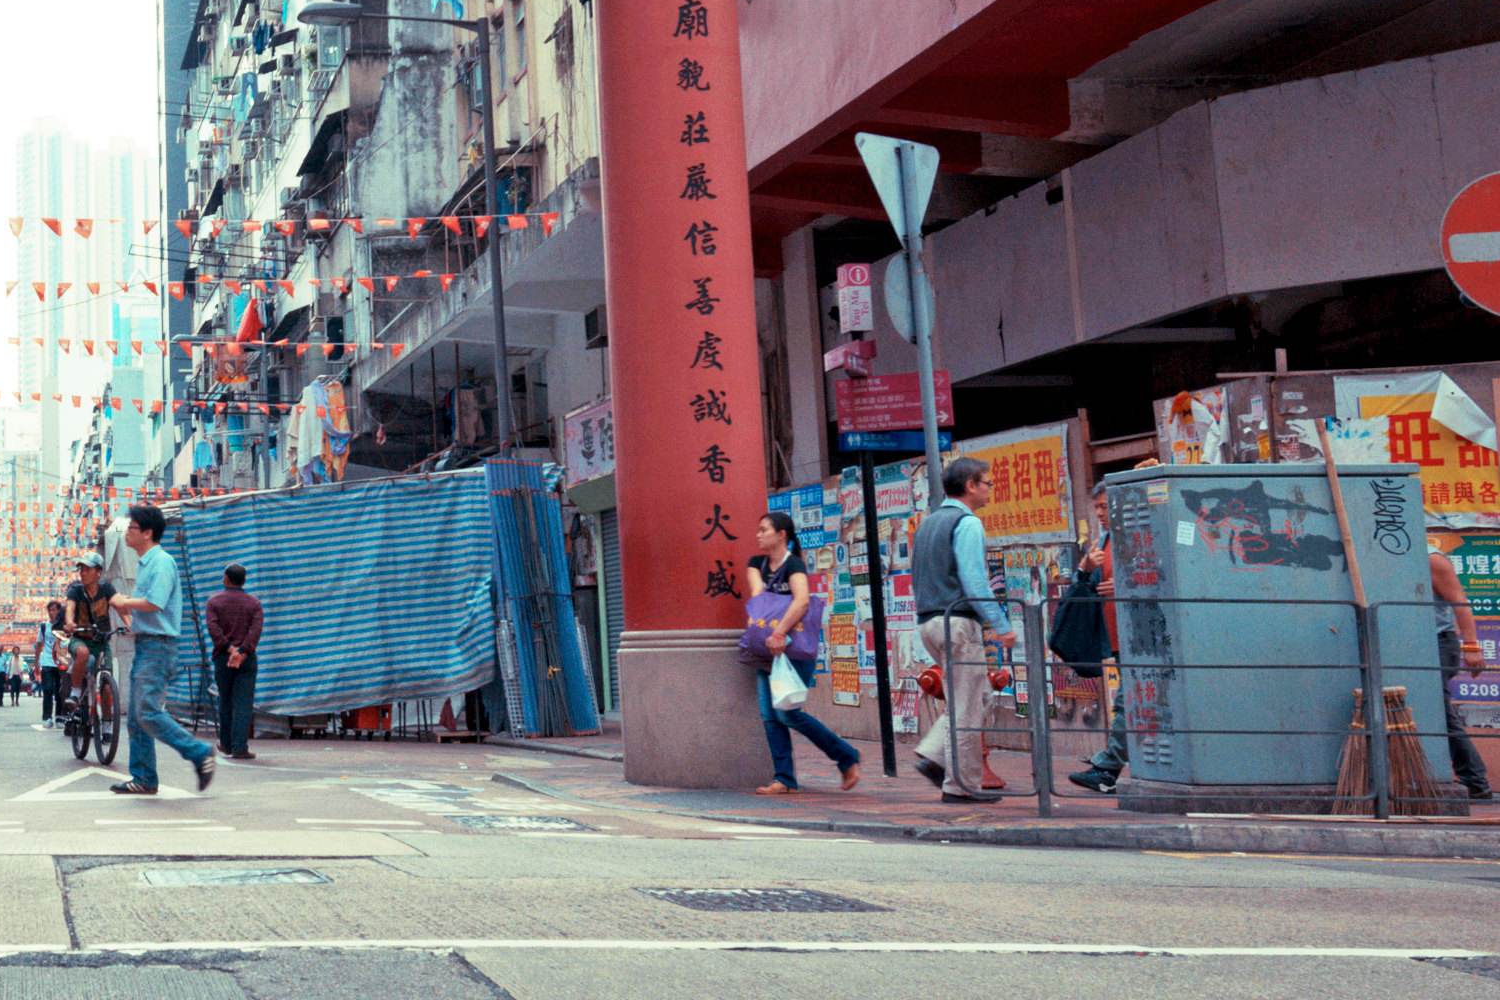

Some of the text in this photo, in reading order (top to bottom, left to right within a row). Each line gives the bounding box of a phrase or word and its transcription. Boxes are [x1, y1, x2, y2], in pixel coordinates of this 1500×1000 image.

[1421, 481, 1498, 505] 請與各
[1460, 683, 1499, 696] 8208
